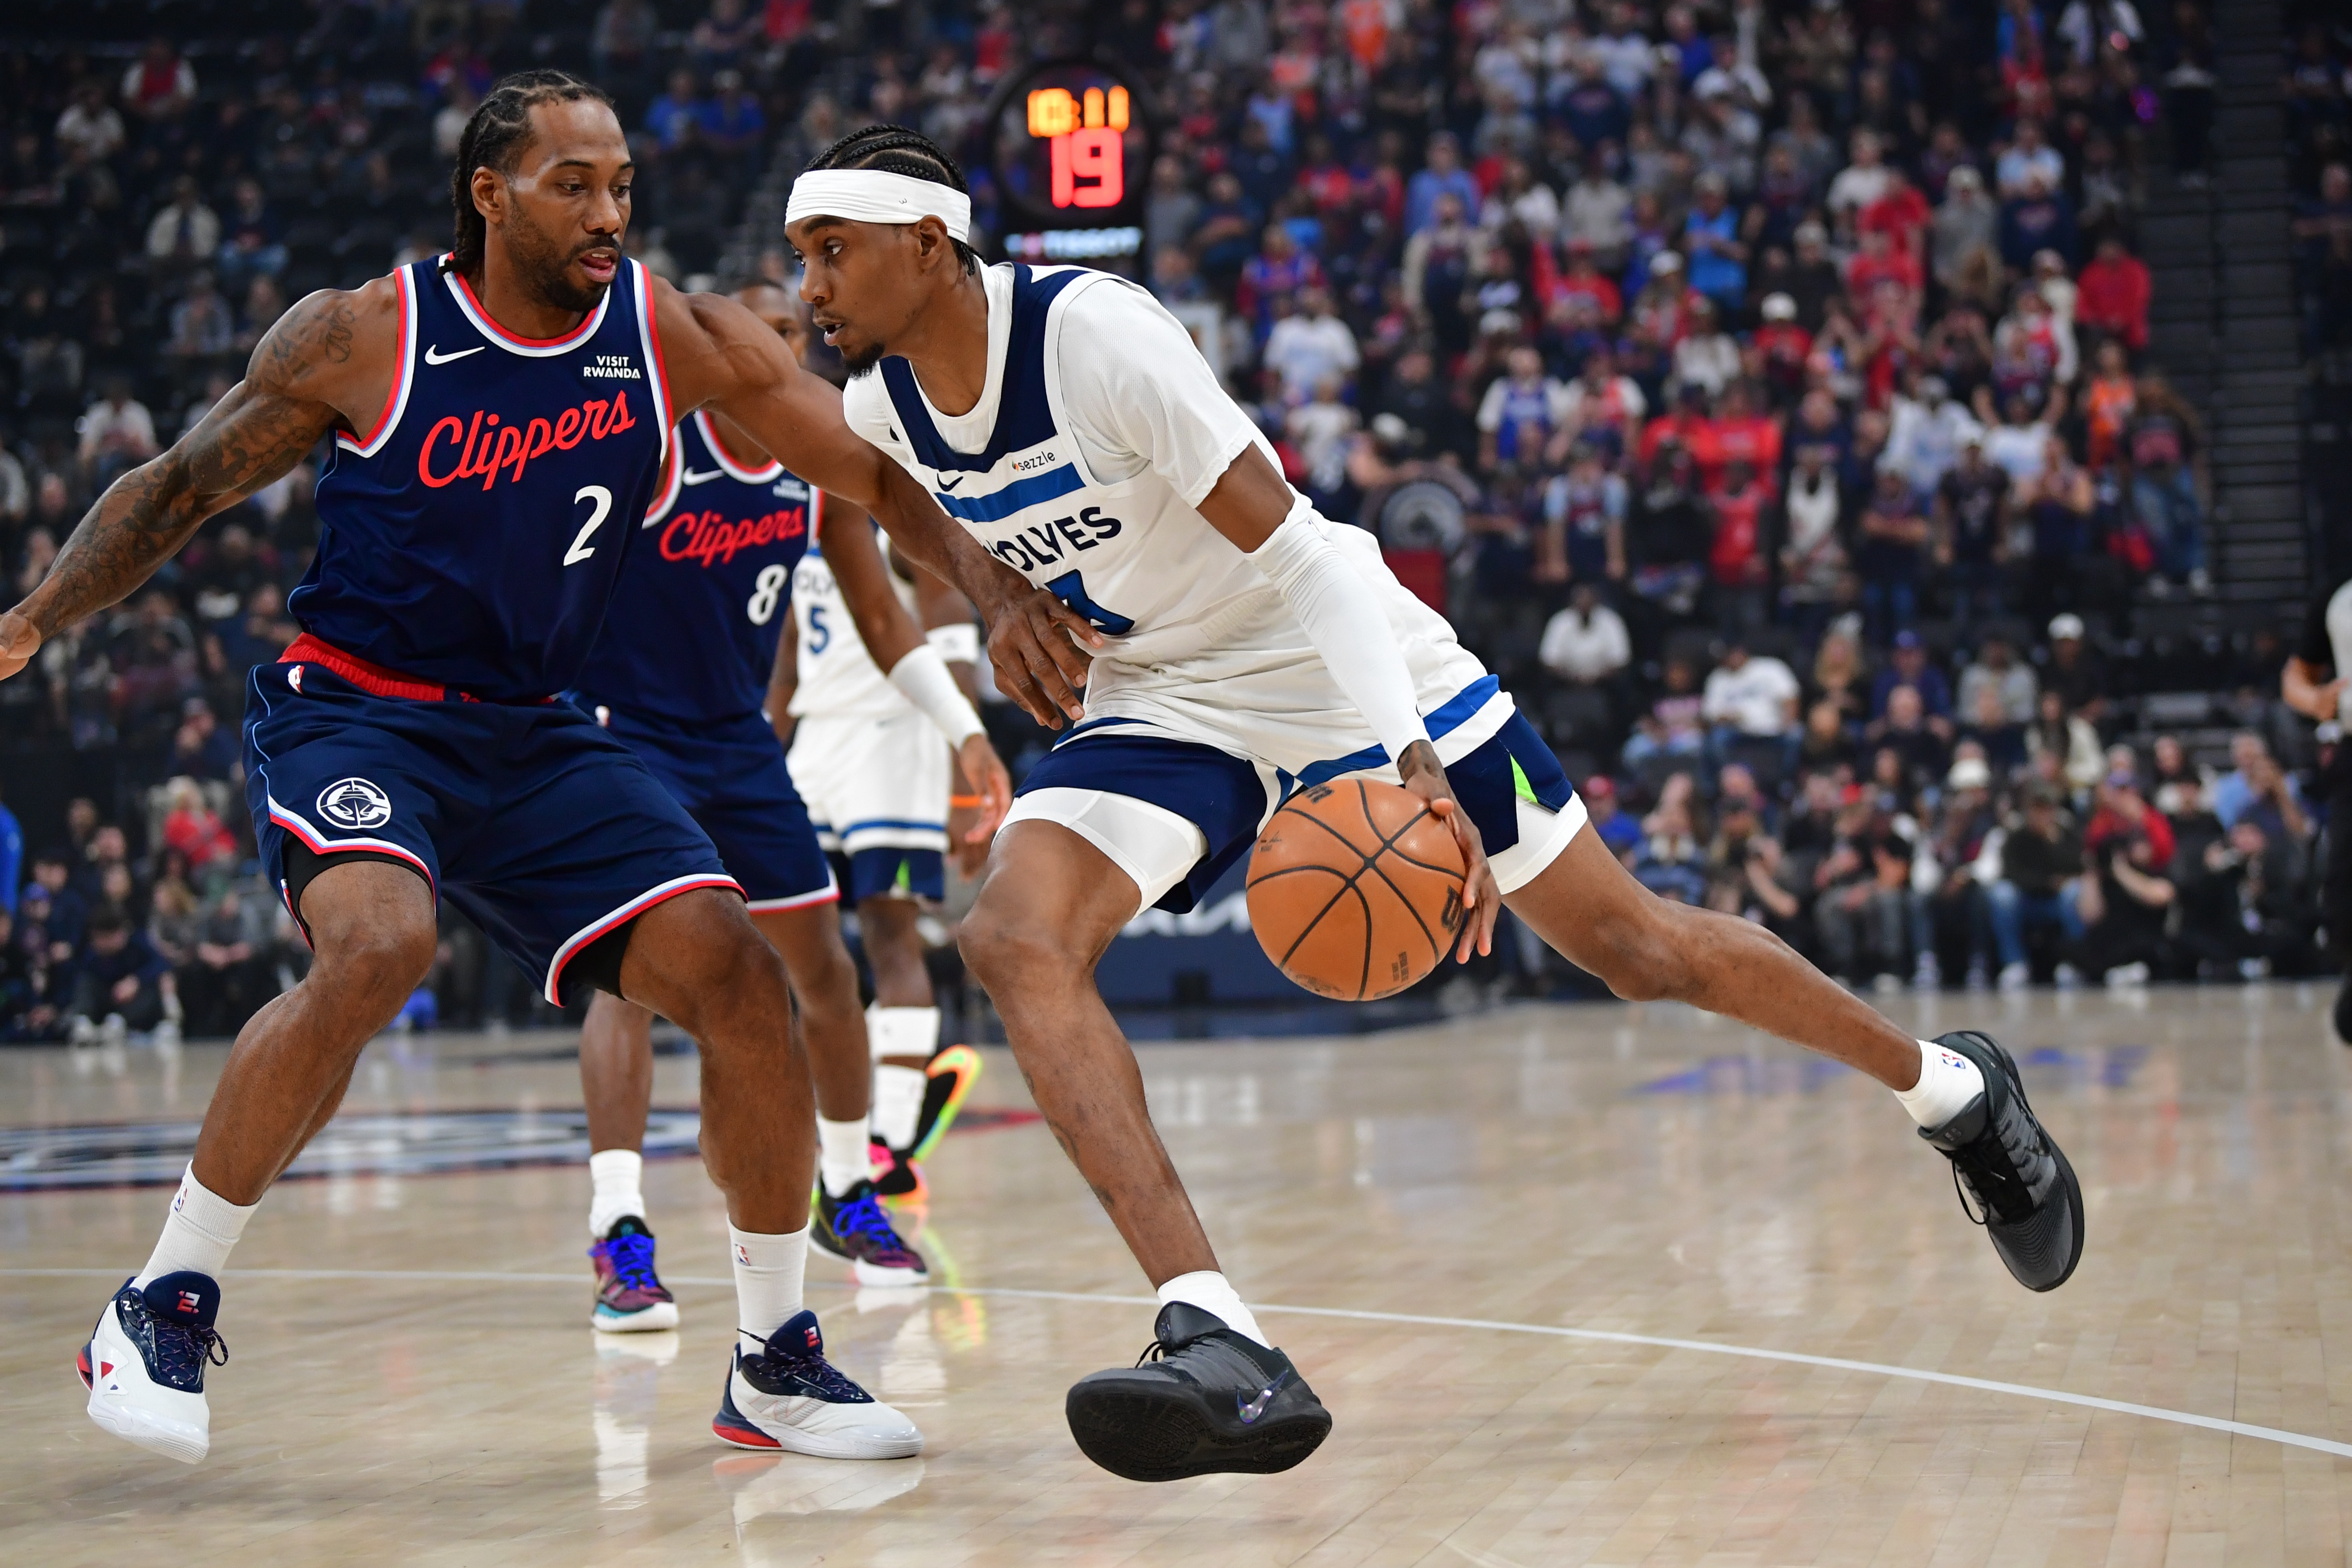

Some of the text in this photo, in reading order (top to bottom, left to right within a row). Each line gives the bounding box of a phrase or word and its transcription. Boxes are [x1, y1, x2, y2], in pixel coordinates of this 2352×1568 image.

[1050, 126, 1123, 208] 19
[583, 366, 641, 379] RWANDA
[596, 355, 629, 367] VISIT
[418, 390, 636, 491] Clippers
[1018, 450, 1055, 471] sezzle
[563, 485, 612, 566] 2
[659, 505, 805, 568] Clippers
[983, 506, 1122, 572] OLVES
[747, 564, 788, 626] 8
[808, 606, 830, 655] 5
